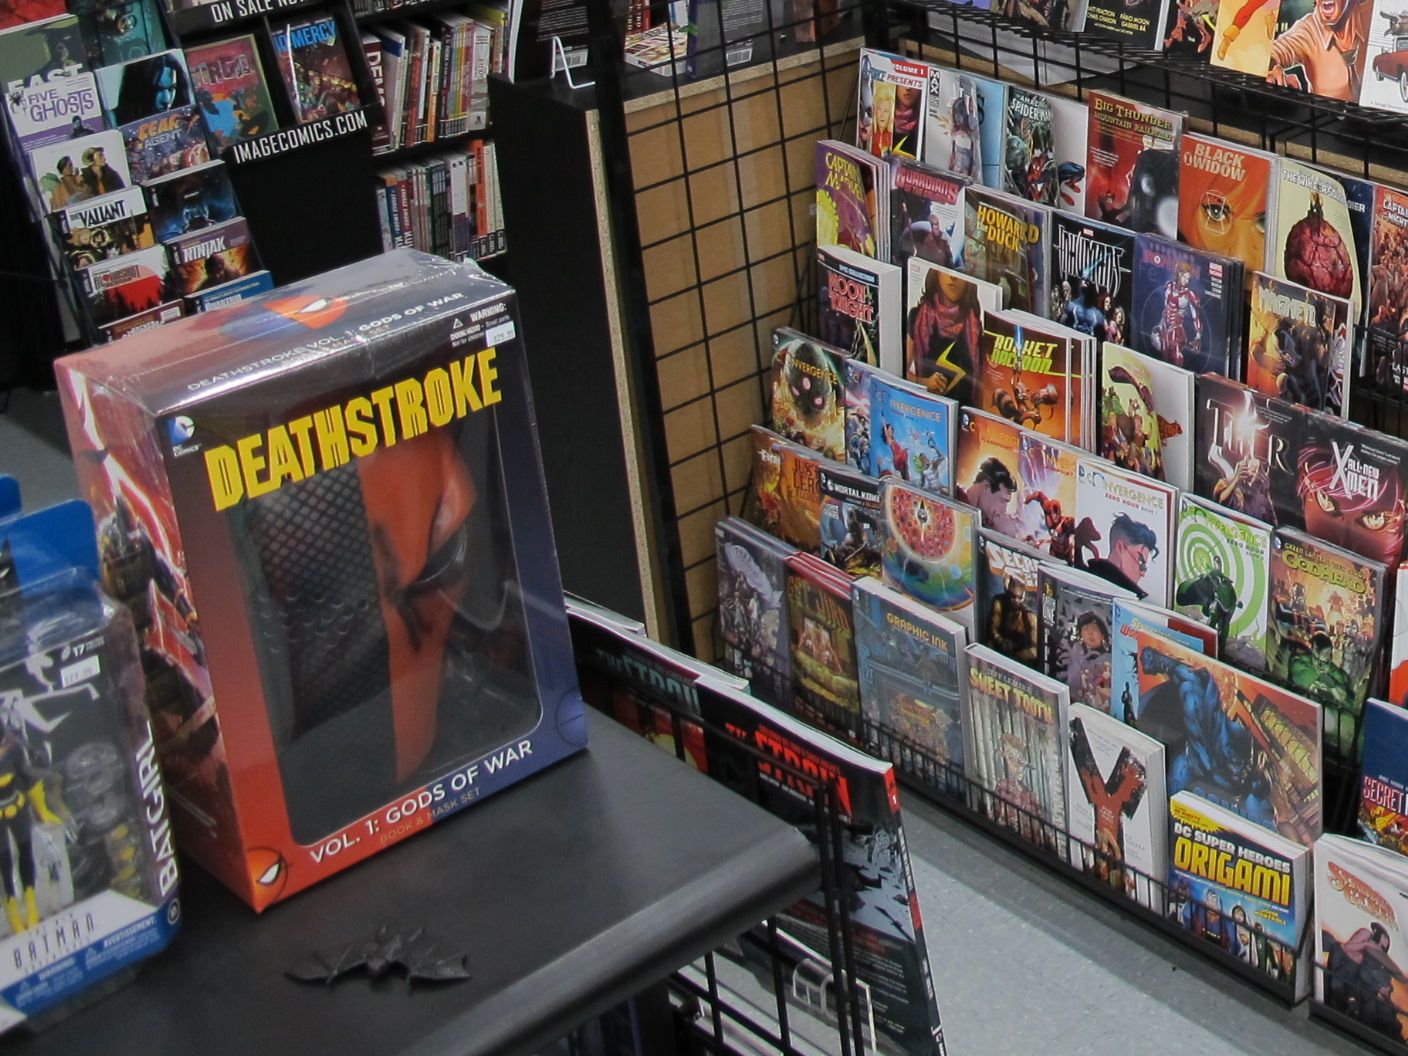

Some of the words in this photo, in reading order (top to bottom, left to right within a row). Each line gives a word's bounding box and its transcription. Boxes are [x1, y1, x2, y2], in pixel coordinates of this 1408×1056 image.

[211, 3, 232, 24] ON
[289, 21, 337, 46] MERCY
[28, 88, 58, 105] FIVE
[886, 74, 924, 89] PRESENTS
[930, 69, 940, 94] MAX
[30, 89, 95, 123] GHOSTS
[1094, 98, 1114, 113] BIG
[1117, 103, 1173, 130] THUNDER
[233, 113, 368, 164] IMAGECOMICS.COM
[1191, 156, 1247, 183] WIDOW
[1194, 143, 1246, 168] BLACK
[80, 199, 127, 228] VALIANT
[986, 225, 1021, 252] DUCK
[358, 315, 402, 333] GODS
[404, 306, 425, 318] OF
[427, 292, 466, 309] WAR
[470, 302, 507, 324] WARNING:
[203, 346, 502, 513] DEATHSTROKE
[1347, 459, 1381, 479] ALL-NEW
[834, 483, 862, 497] MORTAL
[885, 612, 930, 643] GRAPHIC
[931, 632, 949, 652] INK
[968, 666, 1010, 701] SWEET
[1013, 689, 1055, 725] TOOTH
[134, 719, 179, 898] BATGIRL
[308, 831, 361, 865] VOL.
[364, 819, 382, 837] 1:
[385, 782, 447, 825] GODS
[451, 766, 481, 794] OF
[483, 740, 534, 777] WAR
[1362, 775, 1404, 814] SECRET
[1173, 821, 1191, 839] DC
[1193, 827, 1236, 857] SUPER
[1237, 843, 1291, 874] HEROES
[1174, 835, 1291, 907] ORIGAMI
[12, 911, 95, 970] BATMAN
